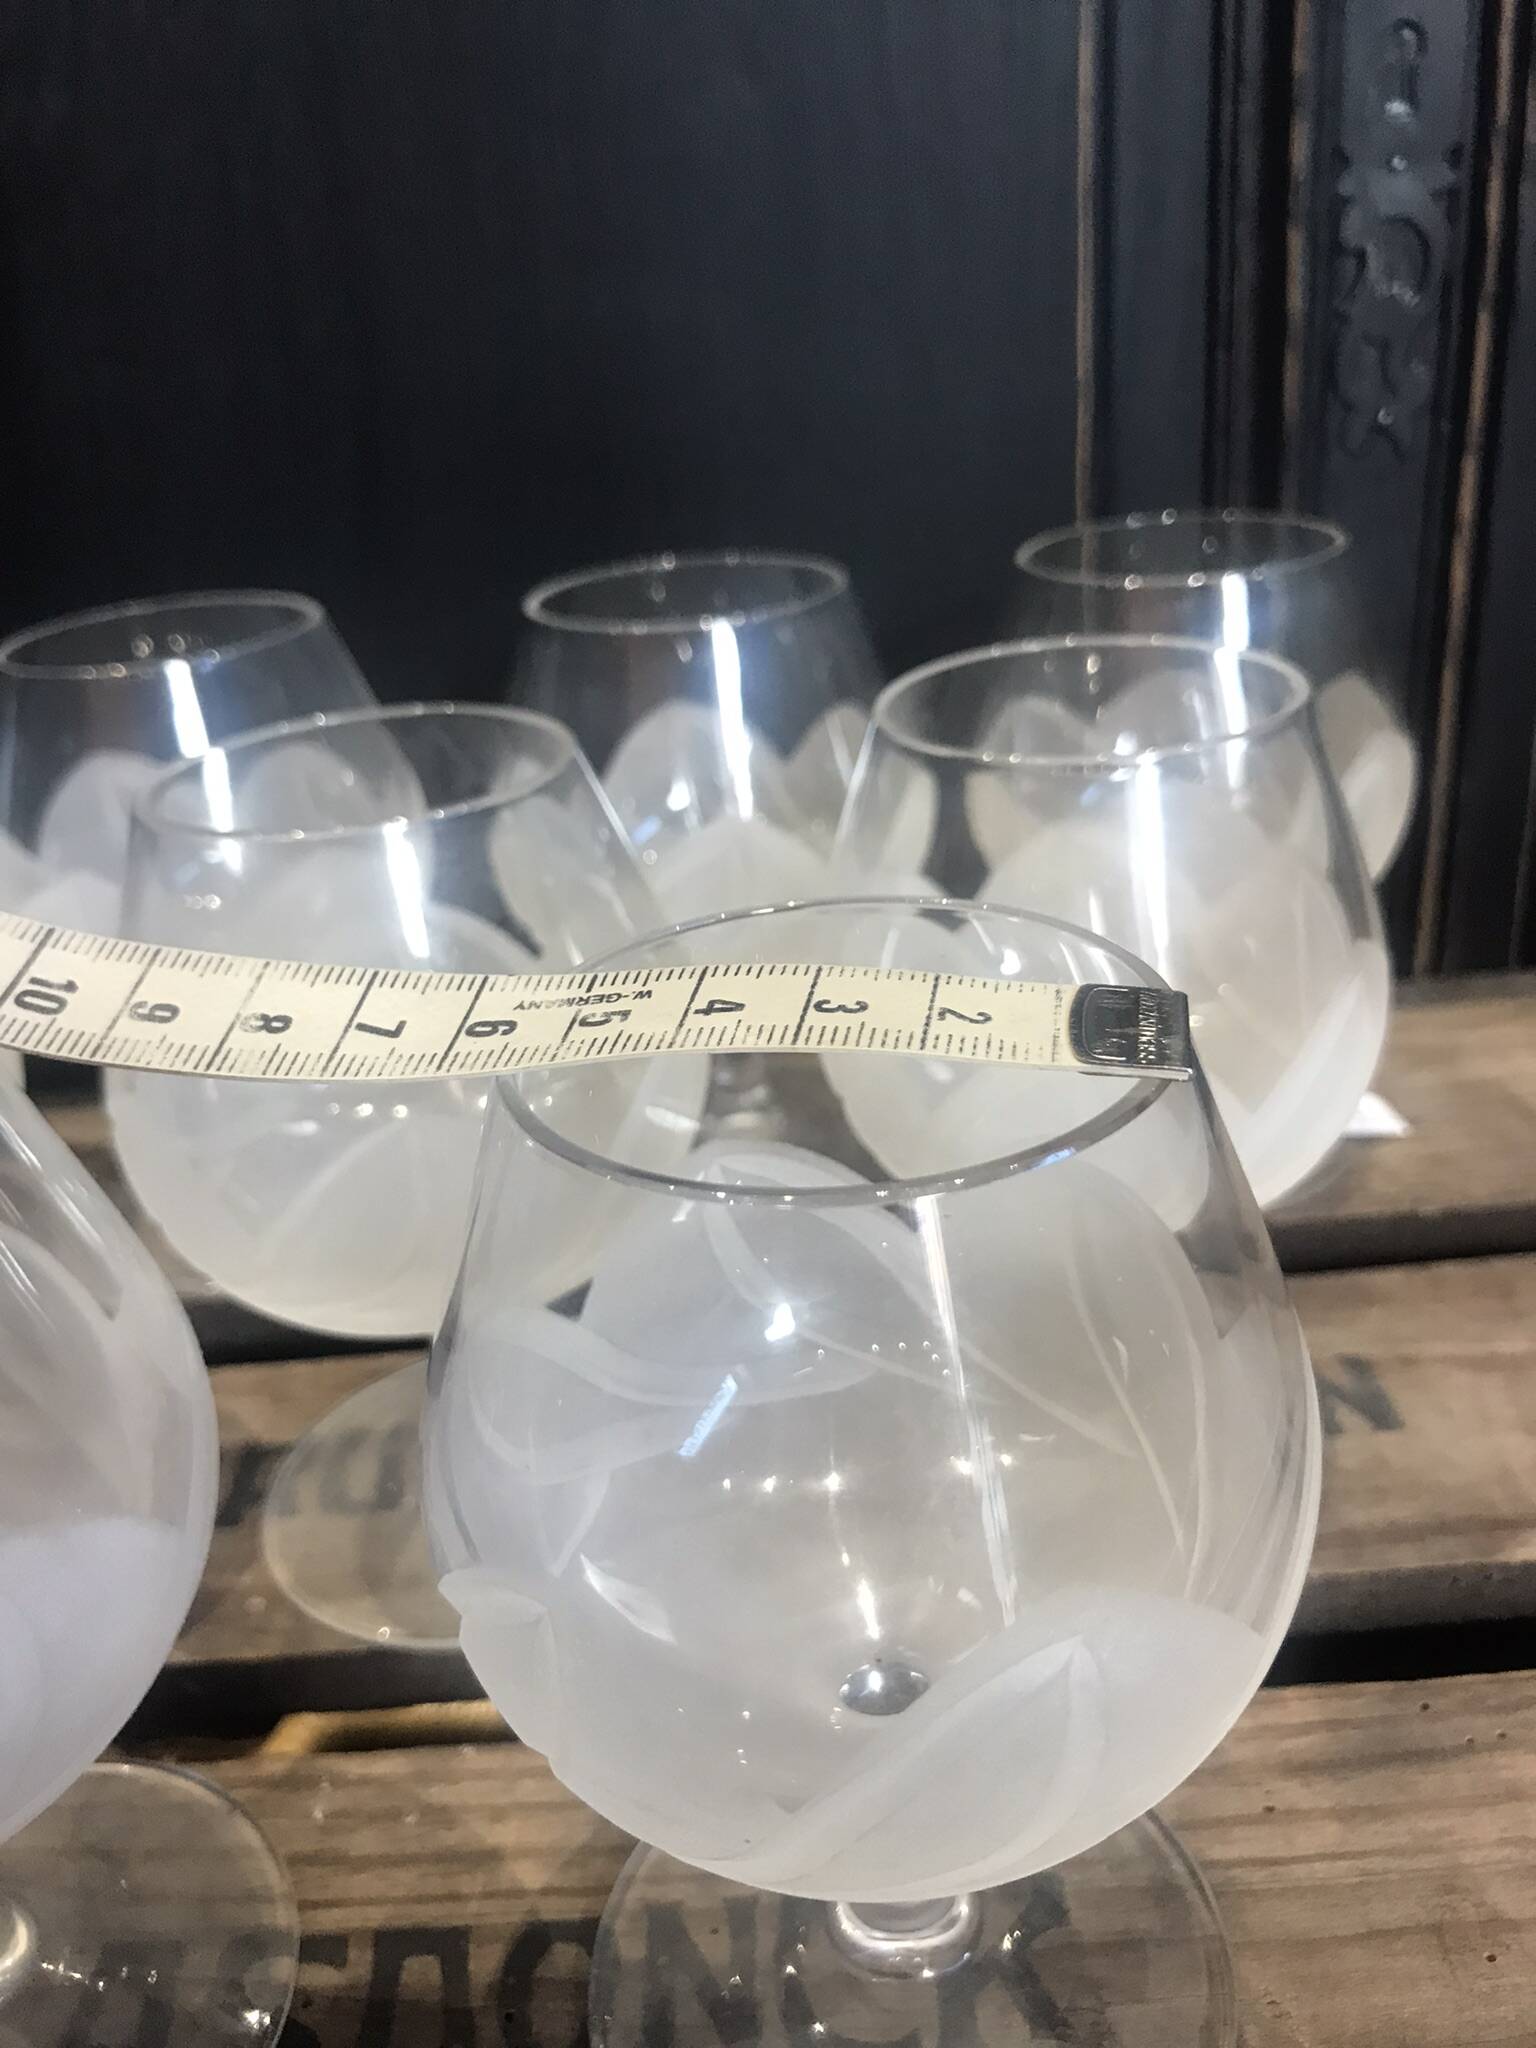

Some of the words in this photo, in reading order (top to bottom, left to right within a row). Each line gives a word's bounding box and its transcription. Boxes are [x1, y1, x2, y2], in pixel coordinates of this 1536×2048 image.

[14, 975, 79, 1016] 10
[129, 1000, 181, 1024] 9
[694, 998, 745, 1016] 4
[814, 998, 869, 1014] 3
[938, 1006, 992, 1025] 2
[239, 1012, 294, 1034] 8
[578, 1009, 632, 1027] 5
[355, 1019, 407, 1039] 7
[465, 1019, 518, 1038] 6
